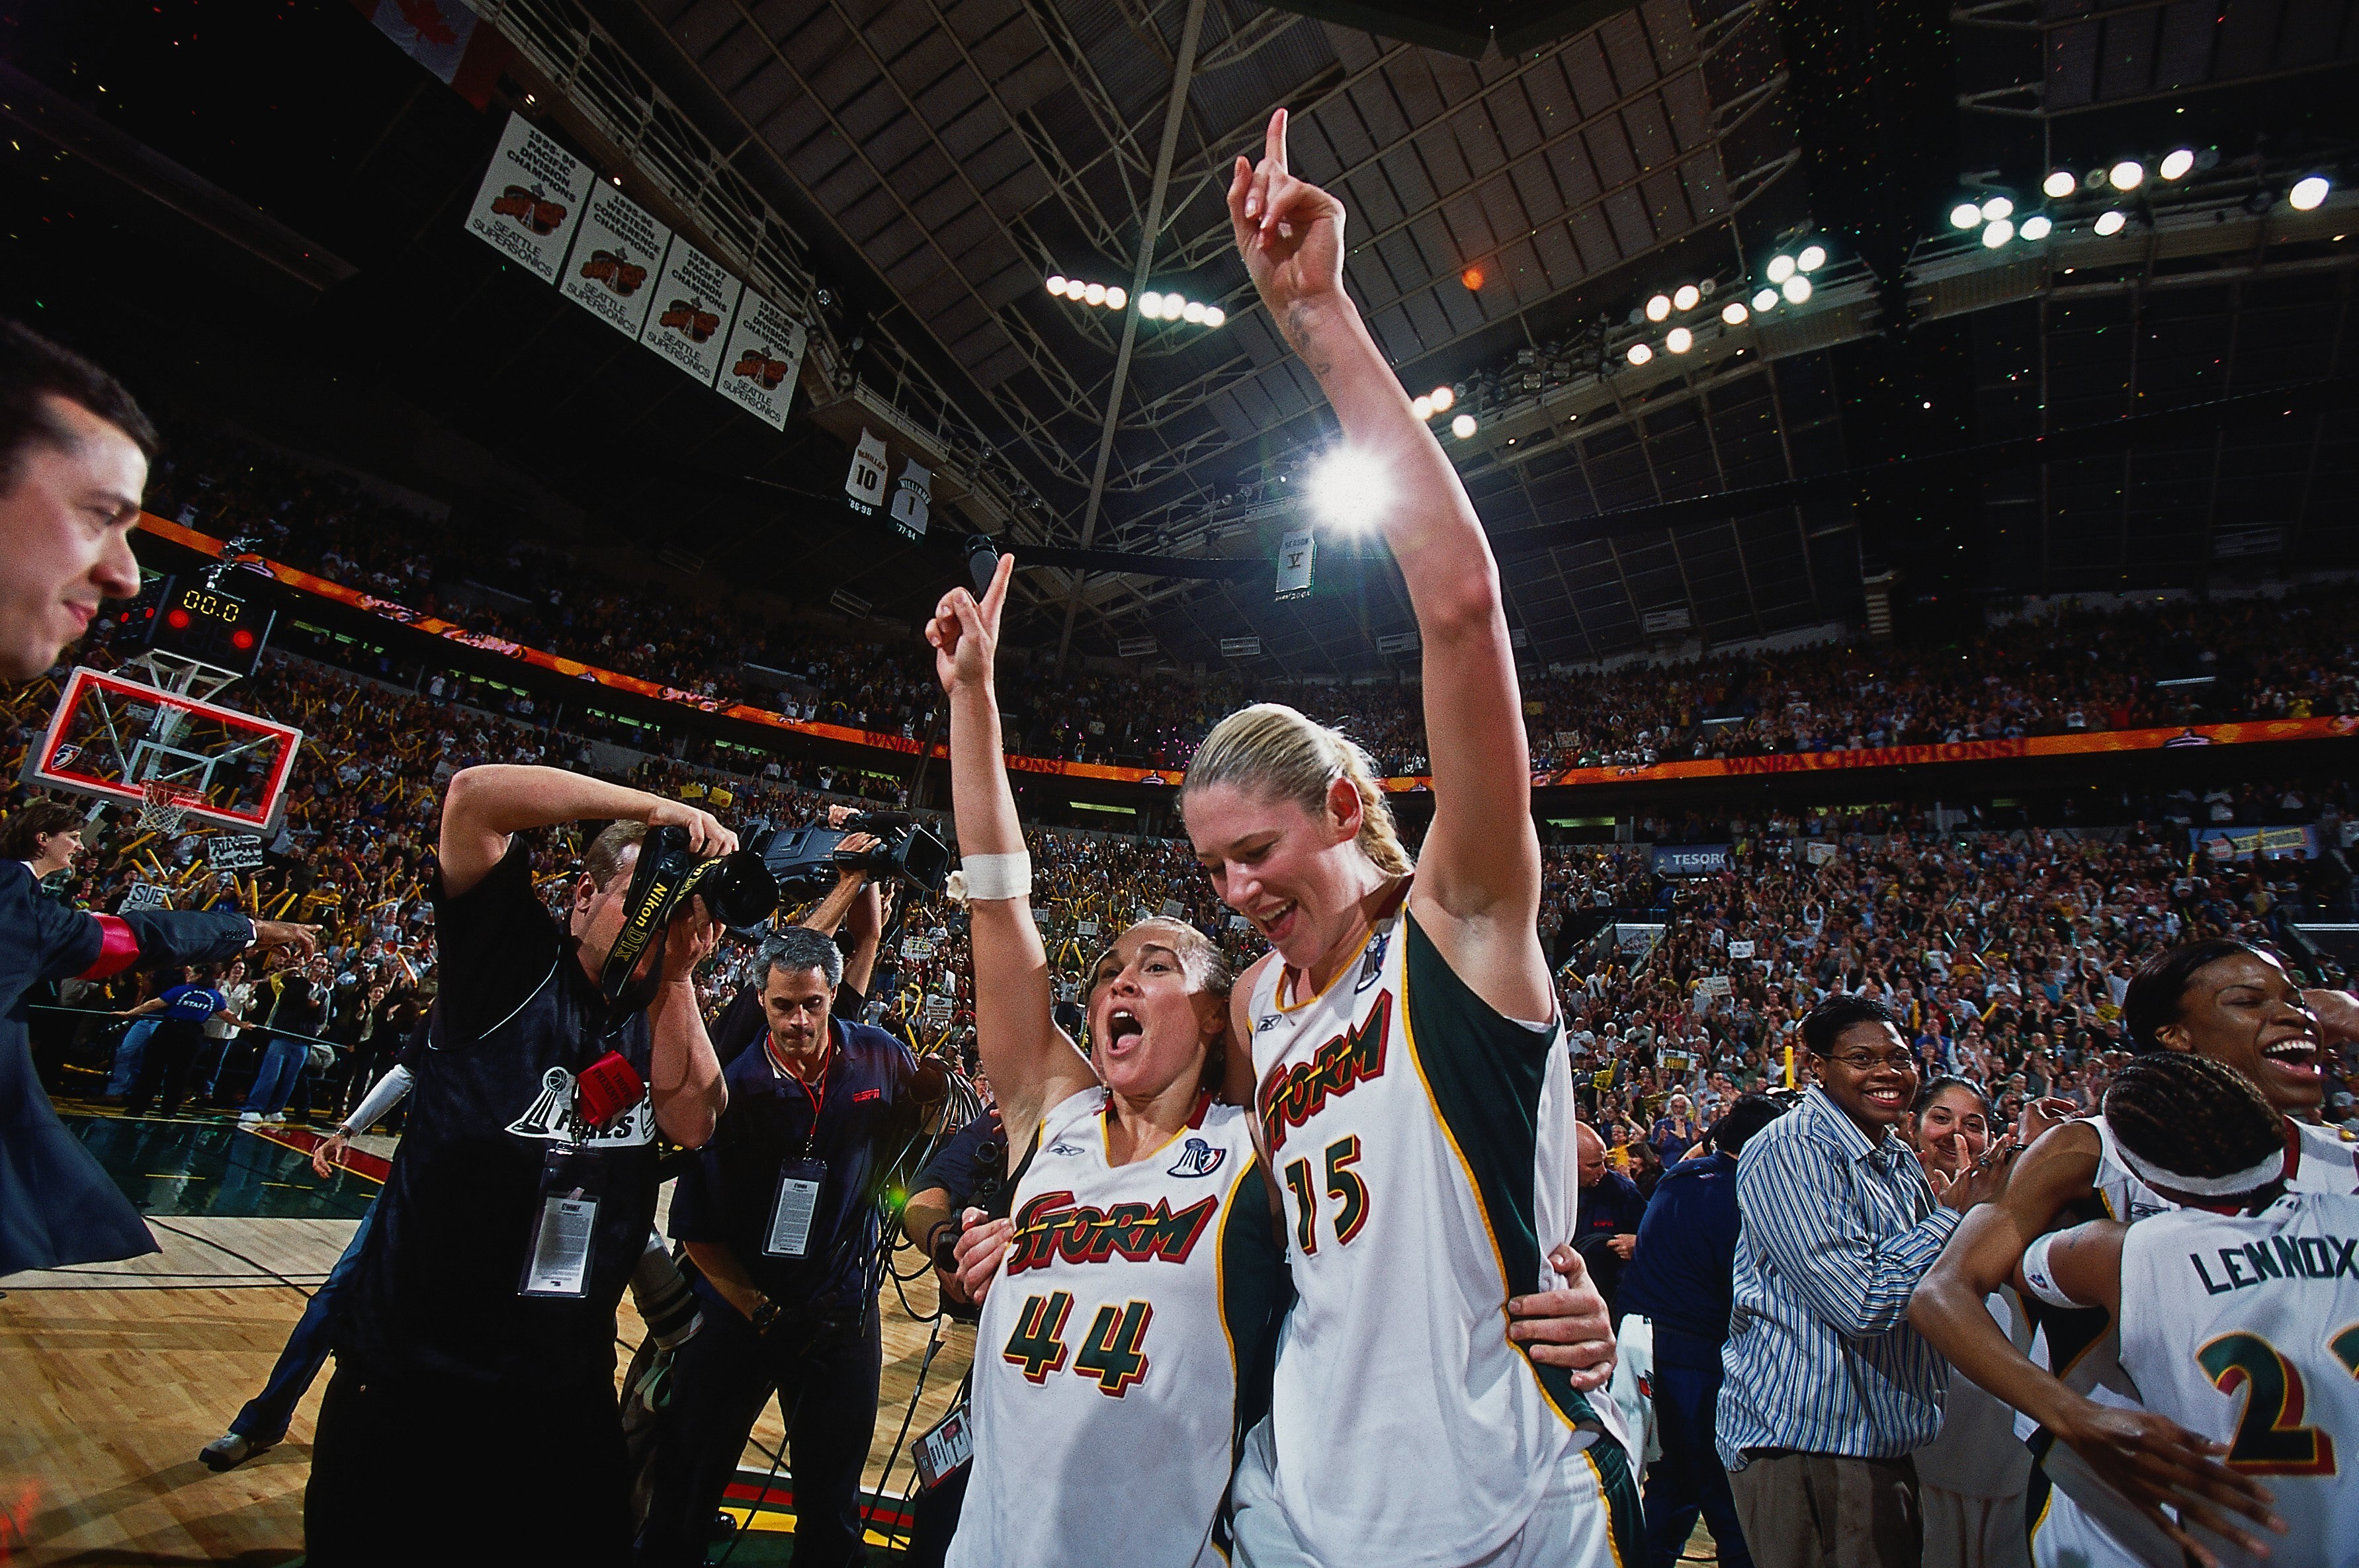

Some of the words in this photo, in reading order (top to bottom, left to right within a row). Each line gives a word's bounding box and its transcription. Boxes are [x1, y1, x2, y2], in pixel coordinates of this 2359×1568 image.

[520, 146, 570, 187] DIVISION
[527, 140, 570, 175] PACIFIC
[529, 130, 576, 169] 1995-96
[507, 149, 576, 202] CHAMPIONS
[495, 220, 541, 257] SEATTLE
[594, 202, 661, 254] CONFERENCE
[594, 213, 655, 261] CHAMPIONS
[607, 200, 655, 240] WESTERN
[473, 218, 553, 277] SUPERSONICS
[671, 269, 727, 313] CHAMPIONS
[681, 266, 722, 299] DIVISION
[687, 259, 722, 289] PACIFIC
[566, 282, 636, 334] SUPERSONICS
[584, 282, 627, 316] SEATTLE
[743, 319, 794, 359] CHAMPIONS
[753, 316, 791, 347] DIVISION
[758, 309, 791, 337] PACIFIC
[647, 331, 710, 379] SUPERSONICS
[663, 331, 701, 362] SEATTLE
[723, 380, 781, 423] SUPERSONICS
[737, 379, 773, 407] SEATTLE
[856, 464, 878, 491] 10
[900, 479, 931, 505] WILLIAMS
[848, 497, 872, 516] '86-98
[908, 495, 916, 516] 1
[896, 522, 916, 540] '77-84
[183, 590, 239, 622] 00.0
[863, 729, 925, 755] WNBA
[1722, 753, 1810, 774] WNBA
[1812, 736, 2028, 769] CHAMPIONS!
[132, 884, 165, 905] SUE
[636, 882, 668, 927] Nikon
[1081, 923, 1095, 932] IT
[183, 1000, 209, 1010] STAFF
[1258, 989, 1393, 1161] STORM
[853, 1089, 879, 1102] ESPN
[1285, 1134, 1370, 1256] 15
[1007, 1190, 1219, 1276] STORM
[2190, 1235, 2359, 1295] LENNOX
[1002, 1290, 1154, 1399] 44
[2195, 1327, 2359, 1477] 2
